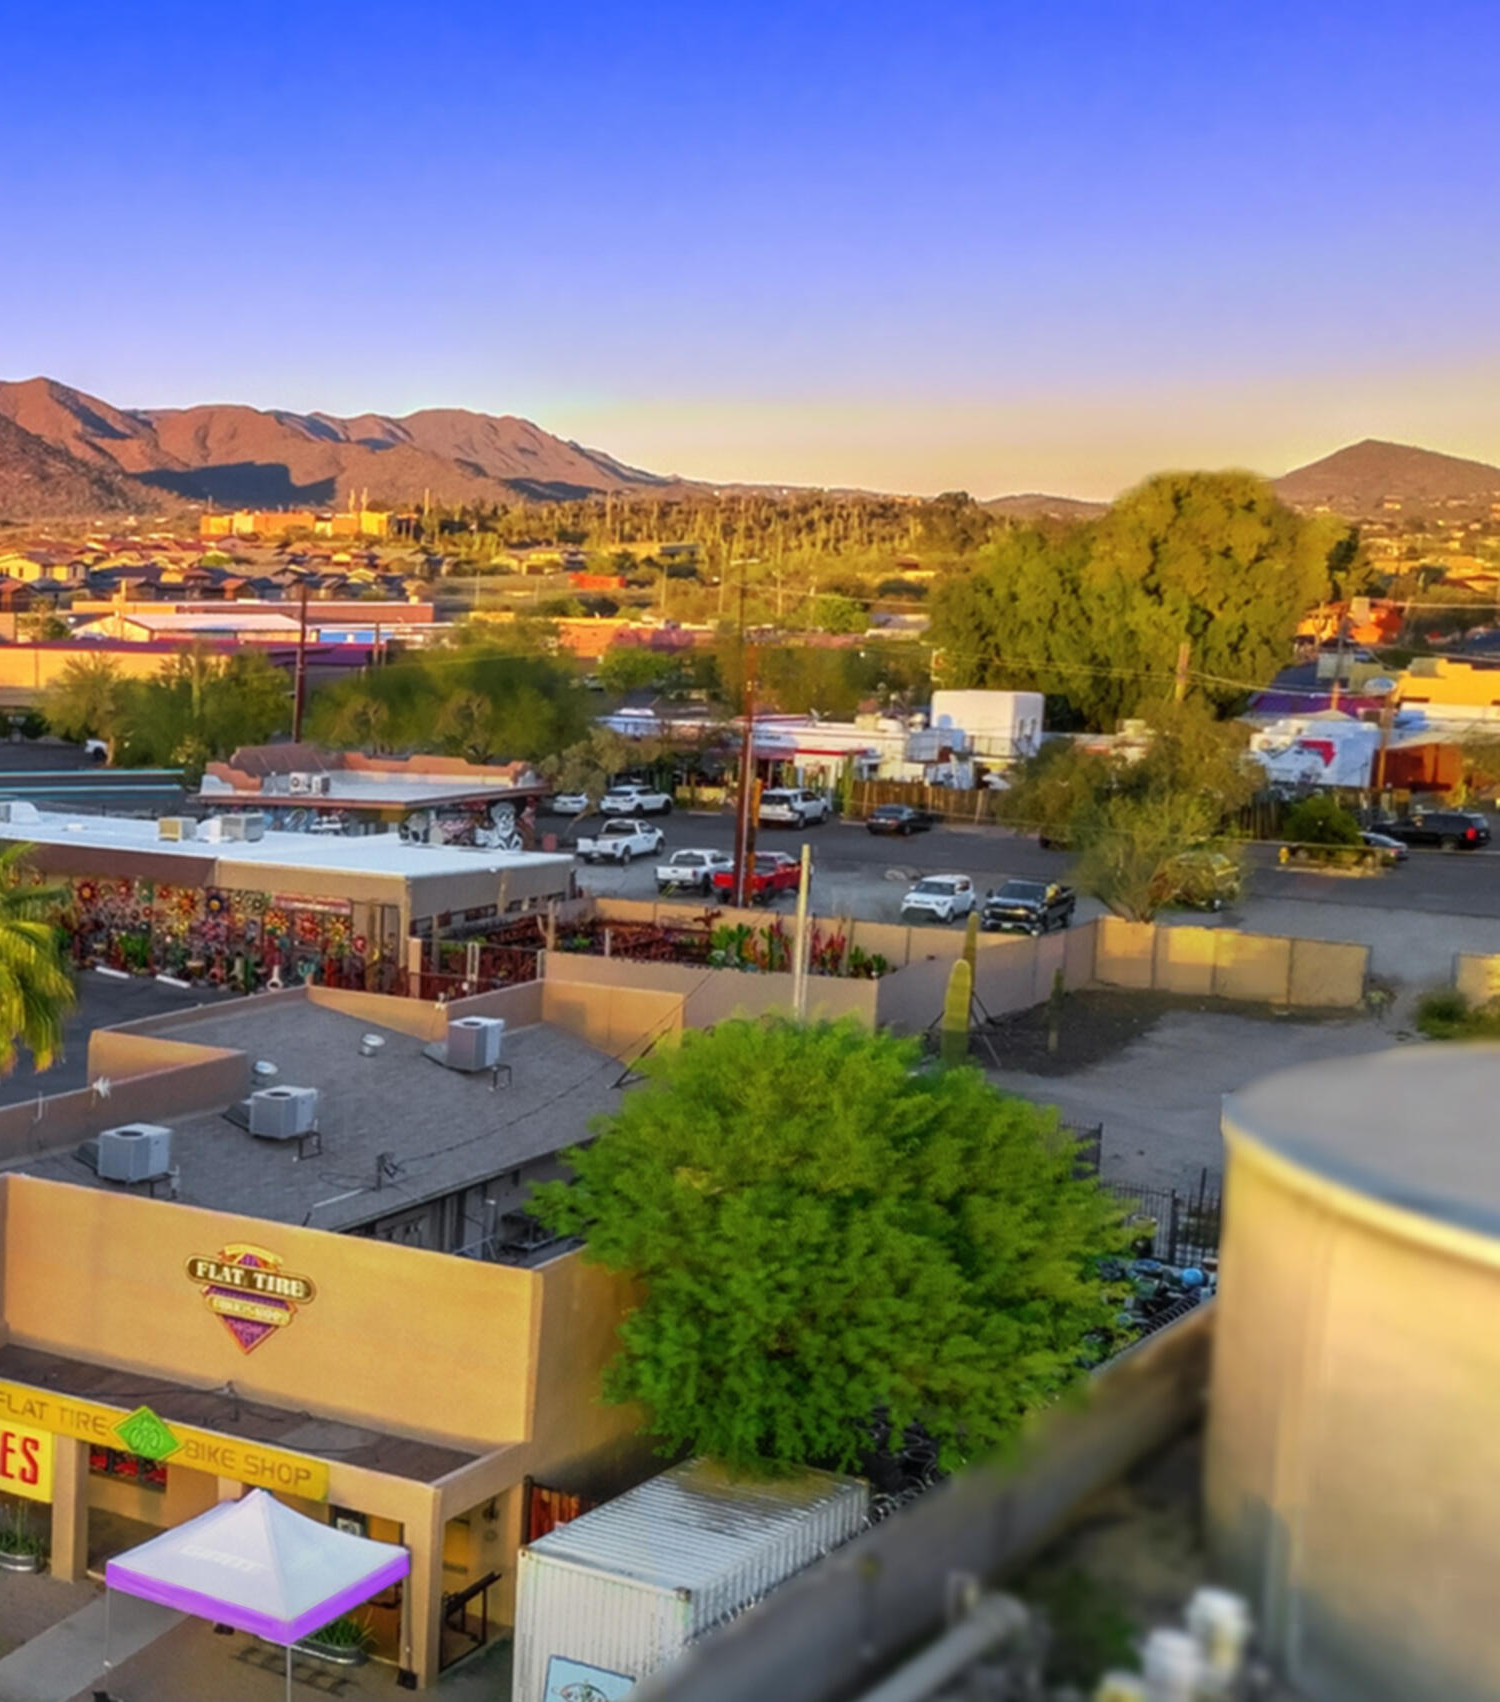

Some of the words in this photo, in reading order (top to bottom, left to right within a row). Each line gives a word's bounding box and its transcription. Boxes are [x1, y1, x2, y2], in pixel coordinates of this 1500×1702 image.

[197, 1261, 244, 1285] FLAT
[253, 1272, 304, 1298] TIRE
[58, 1407, 107, 1436] TIRE
[184, 1438, 236, 1469] BIKE
[243, 1453, 312, 1486] SHOP
